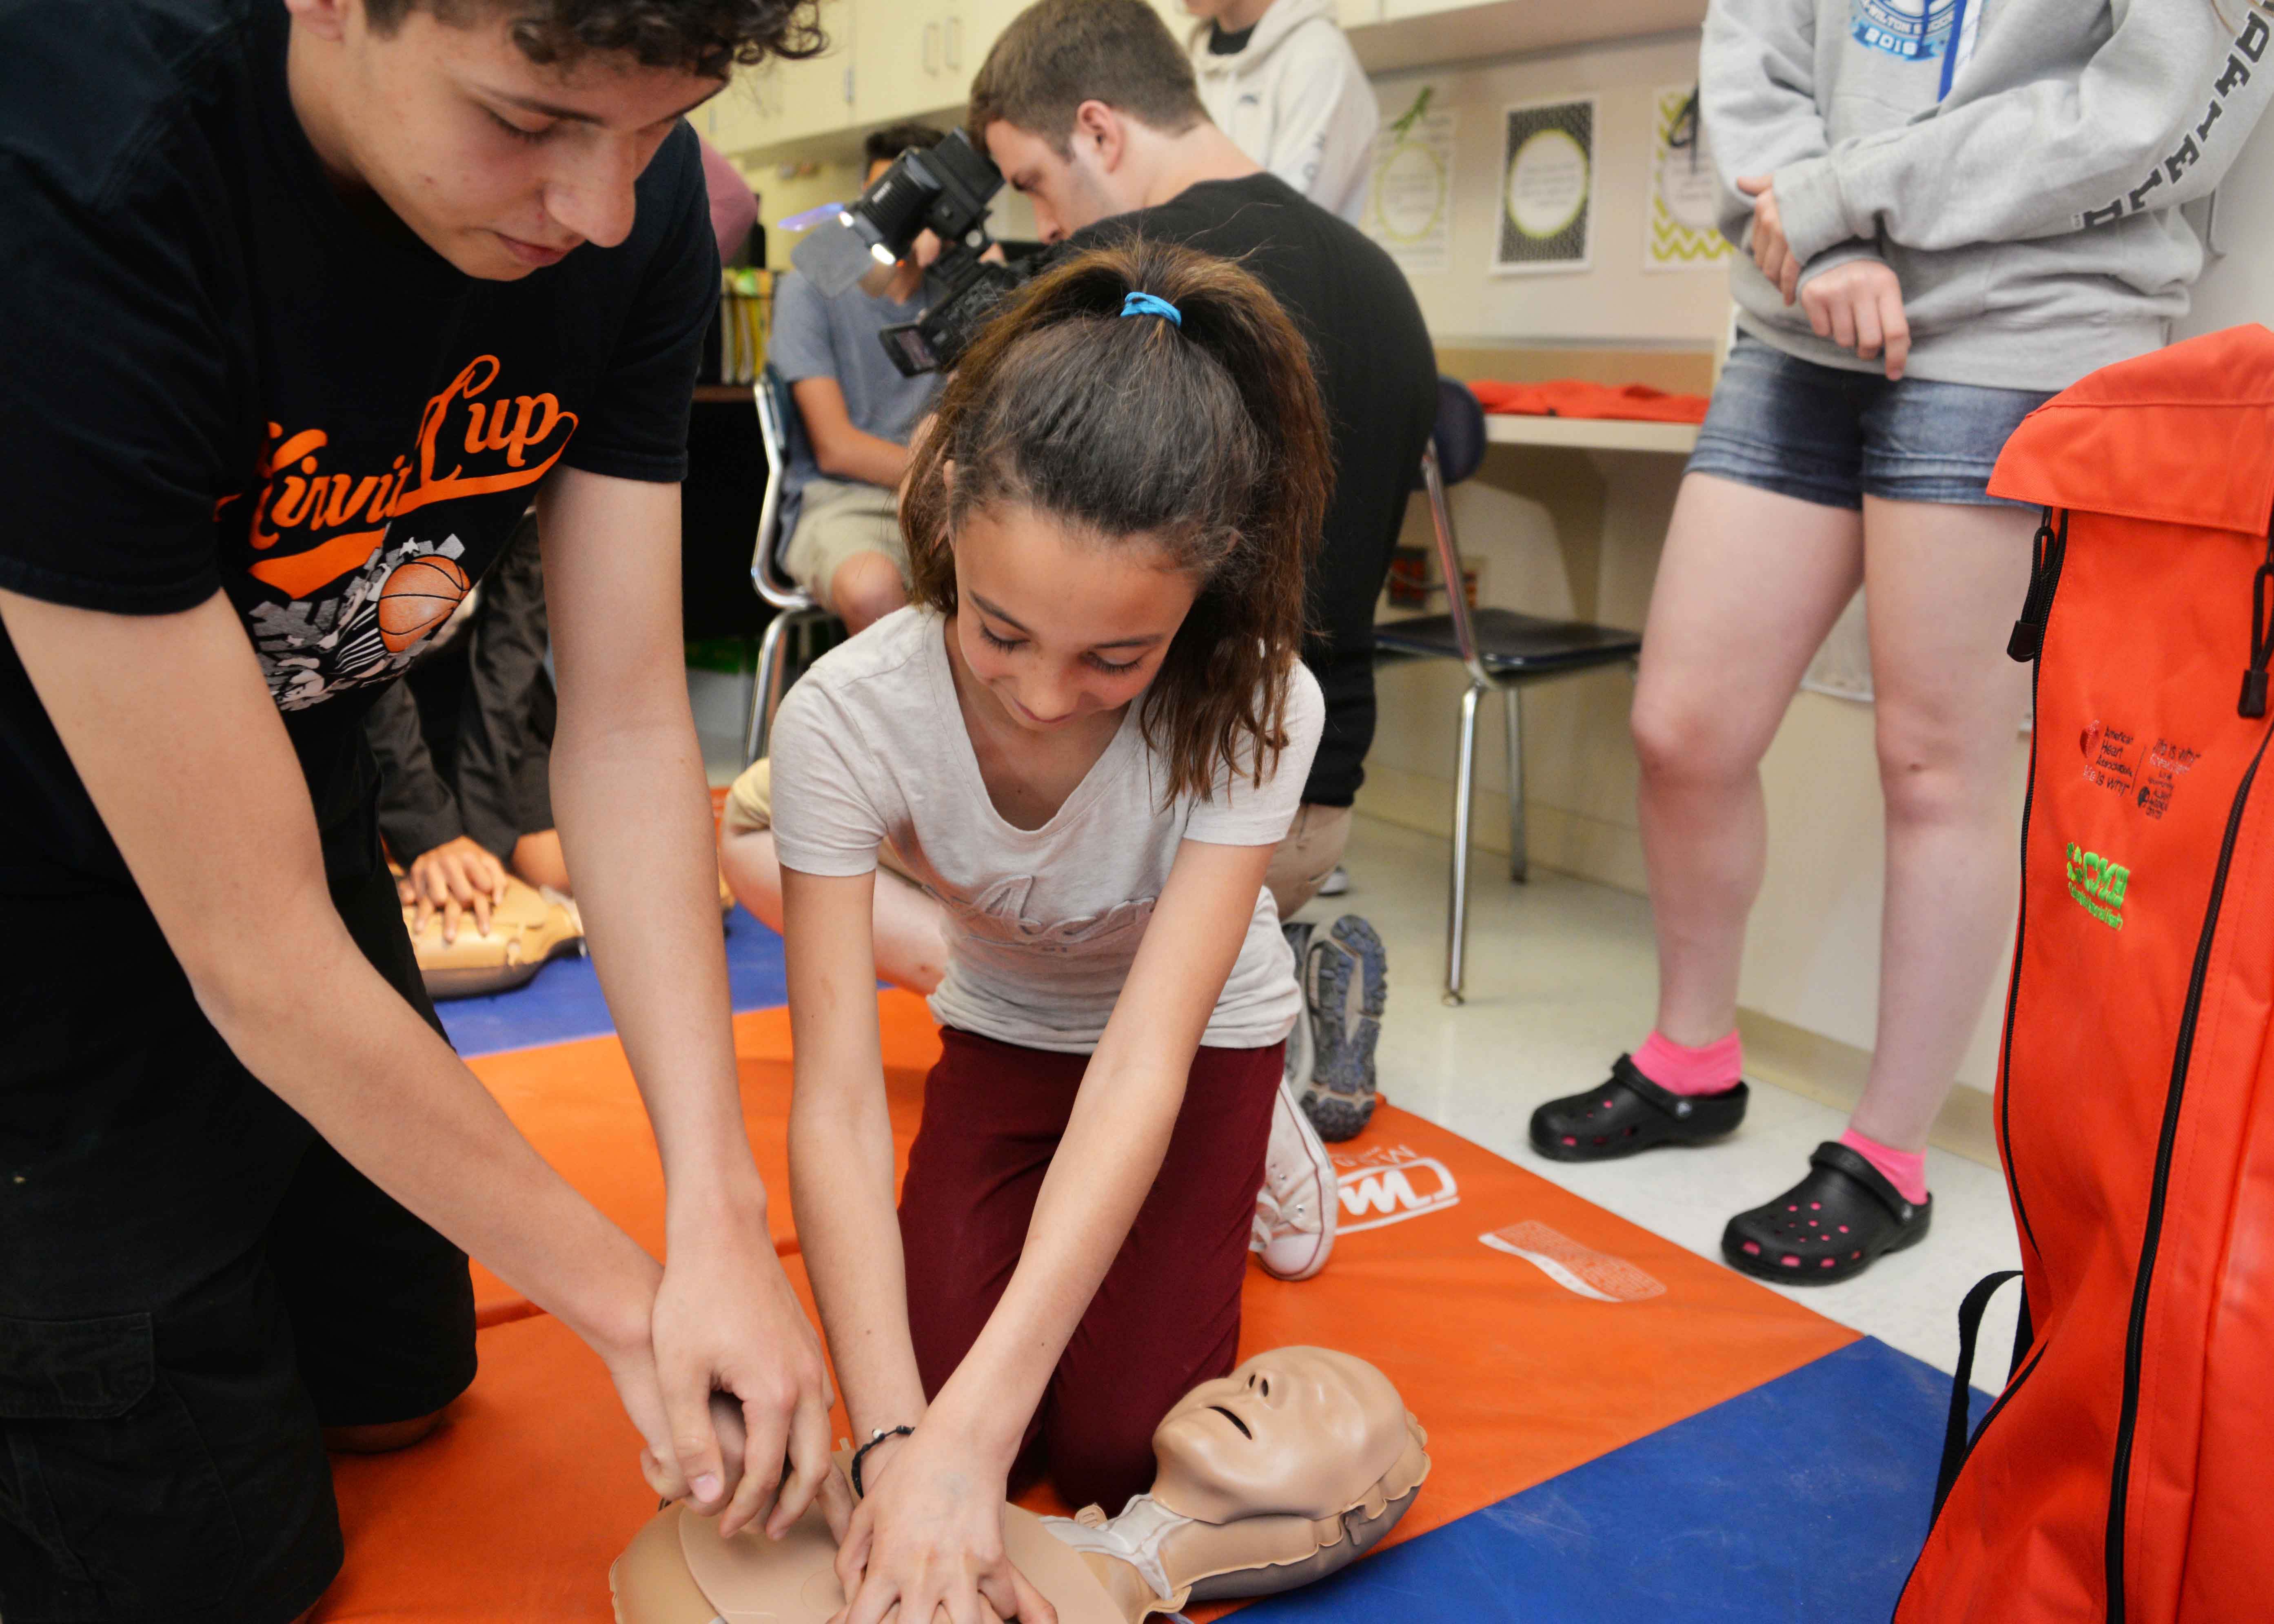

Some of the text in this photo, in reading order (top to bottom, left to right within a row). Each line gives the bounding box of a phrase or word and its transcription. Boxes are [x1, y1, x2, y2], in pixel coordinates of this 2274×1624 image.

[414, 354, 560, 488] Cup
[2102, 739, 2123, 759] Heart
[2083, 851, 2130, 910] CMH
